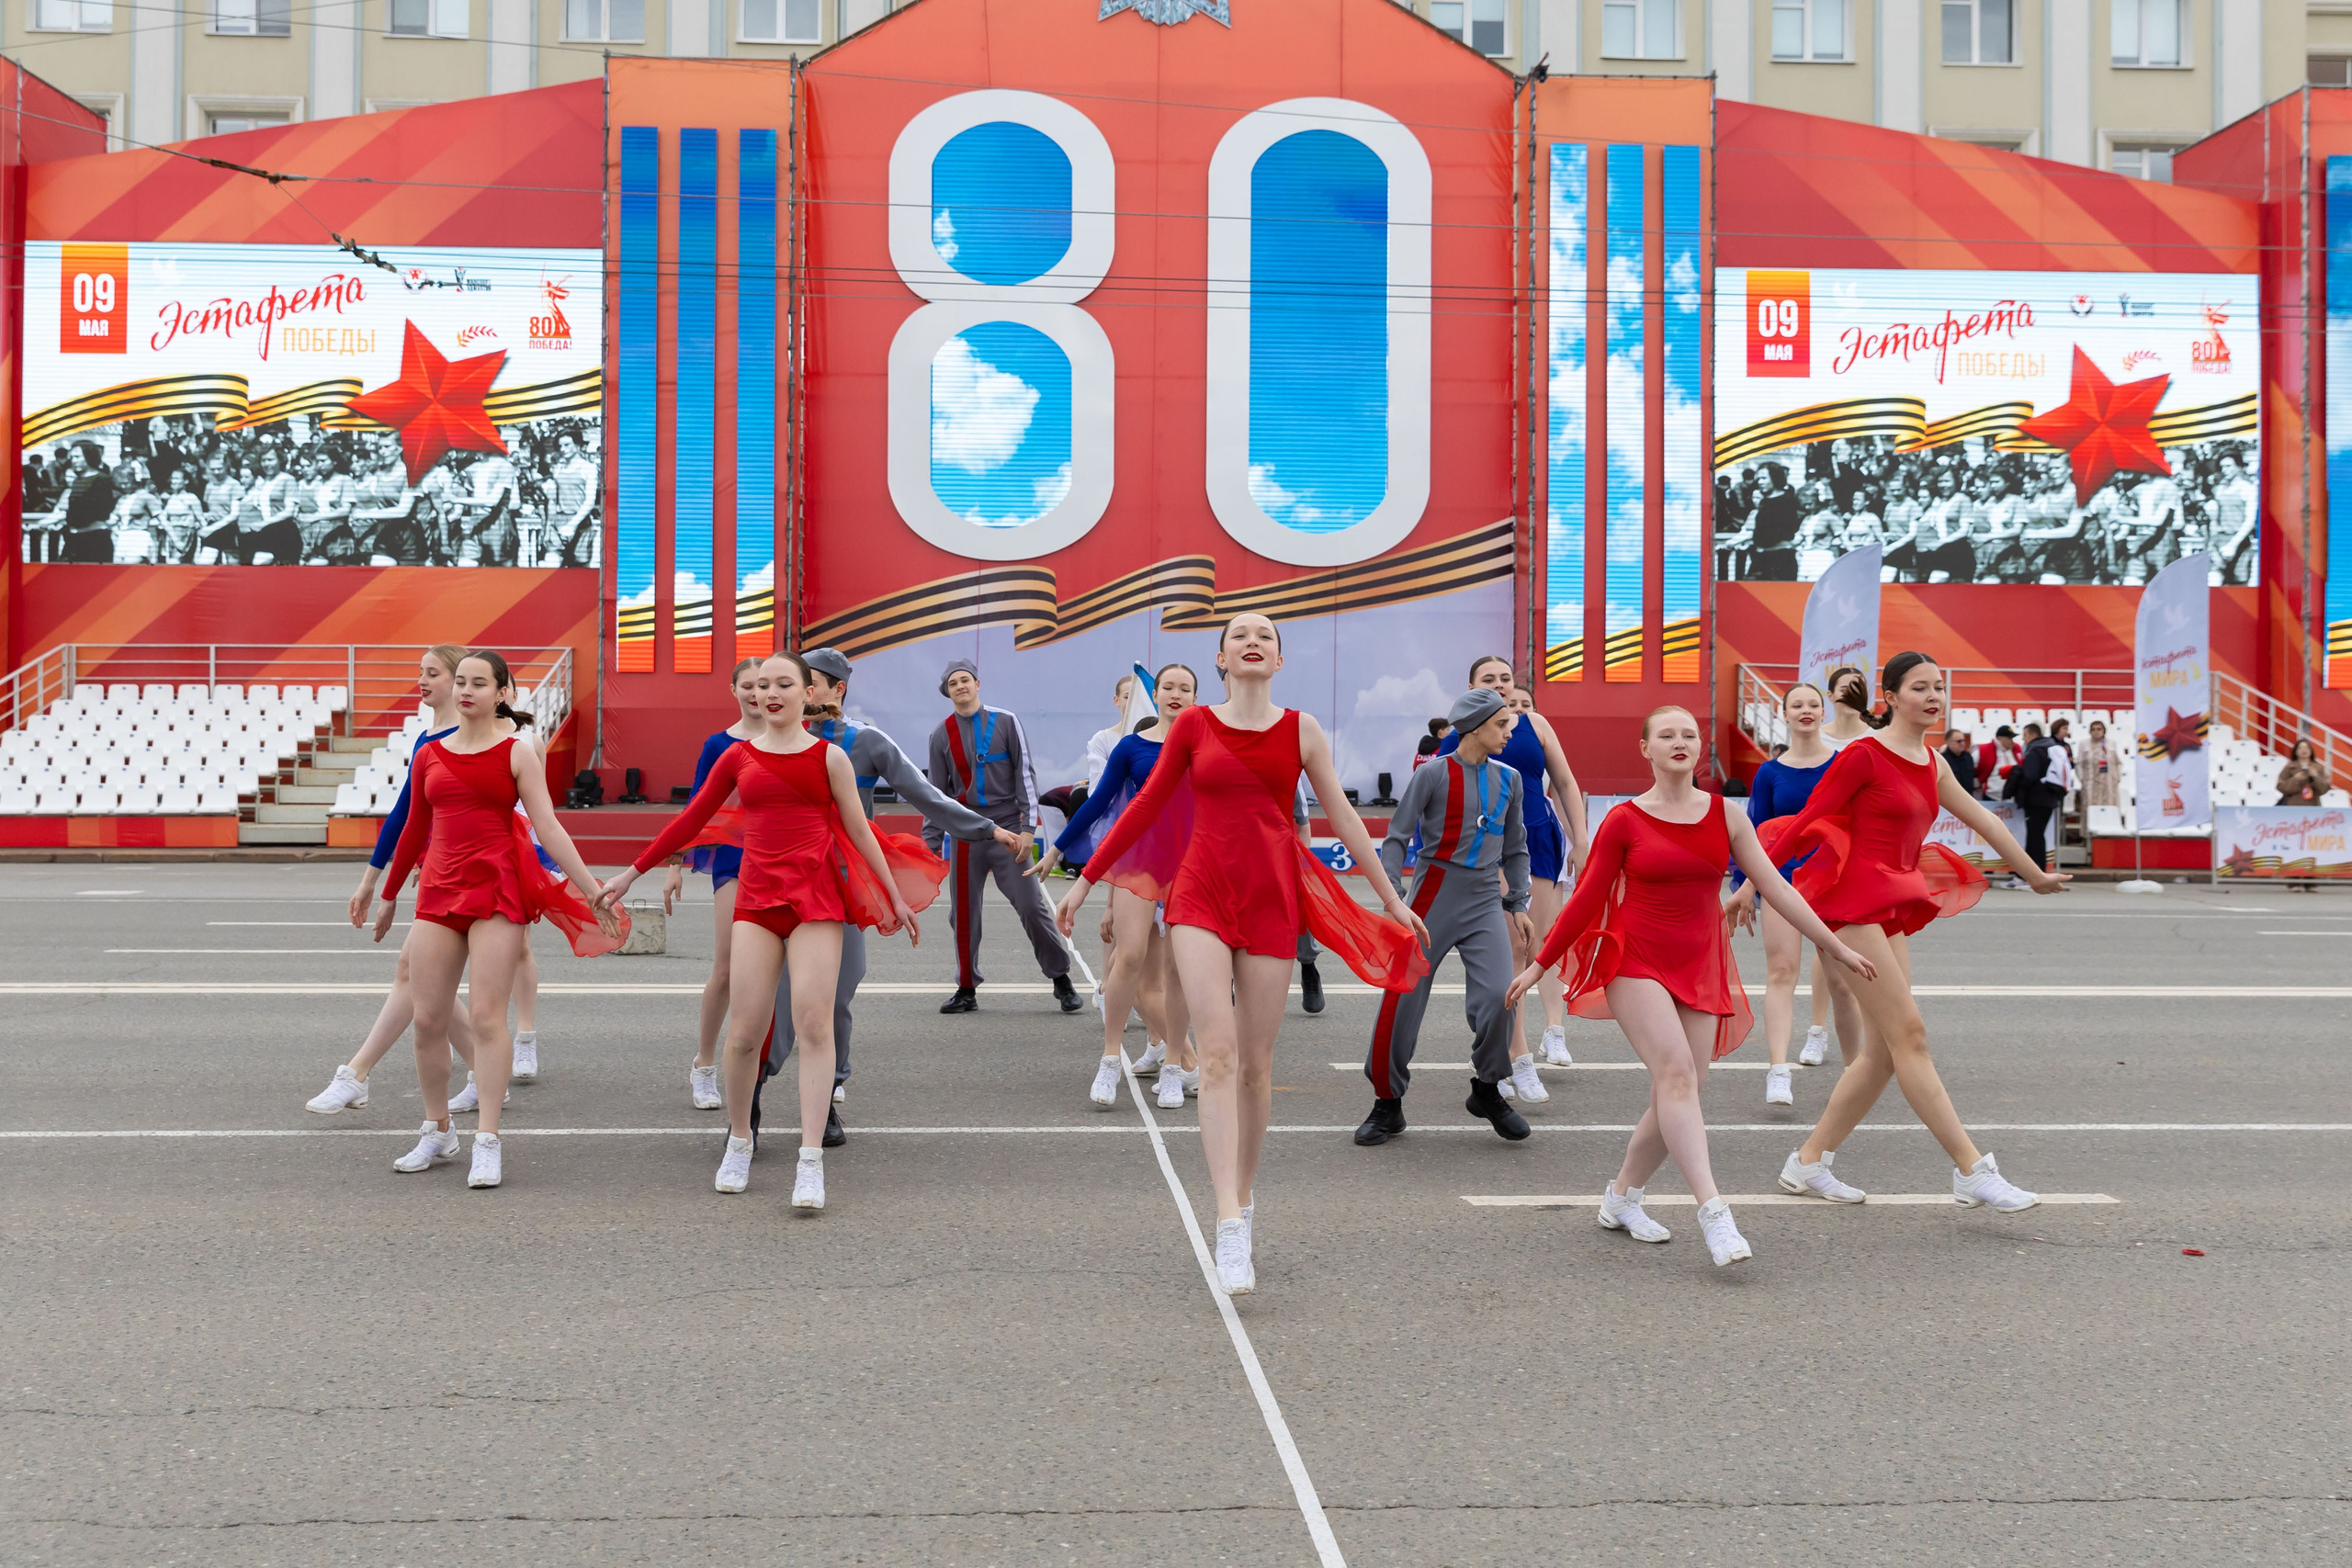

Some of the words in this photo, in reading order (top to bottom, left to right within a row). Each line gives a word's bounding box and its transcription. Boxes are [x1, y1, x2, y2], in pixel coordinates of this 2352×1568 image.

[74, 273, 116, 313] 09
[79, 320, 108, 337] МАЯ
[151, 274, 368, 362] Эстафета
[529, 316, 552, 337] 80
[888, 88, 1432, 568] 80
[1758, 299, 1799, 337] 09
[282, 327, 376, 355] ПОБЕДЫ
[528, 340, 572, 350] ПОБЕДА!
[1764, 344, 1792, 361] МАЯ
[1833, 299, 2036, 385] Эстафета
[2192, 341, 2212, 361] 80
[1958, 352, 2045, 378] ПОБЕДЫ
[1810, 638, 1867, 668] Эстафета
[2150, 669, 2188, 688] МИРА
[2252, 810, 2345, 851] Эстафета
[2307, 835, 2346, 852] МИРА
[1330, 842, 1352, 872] 3
